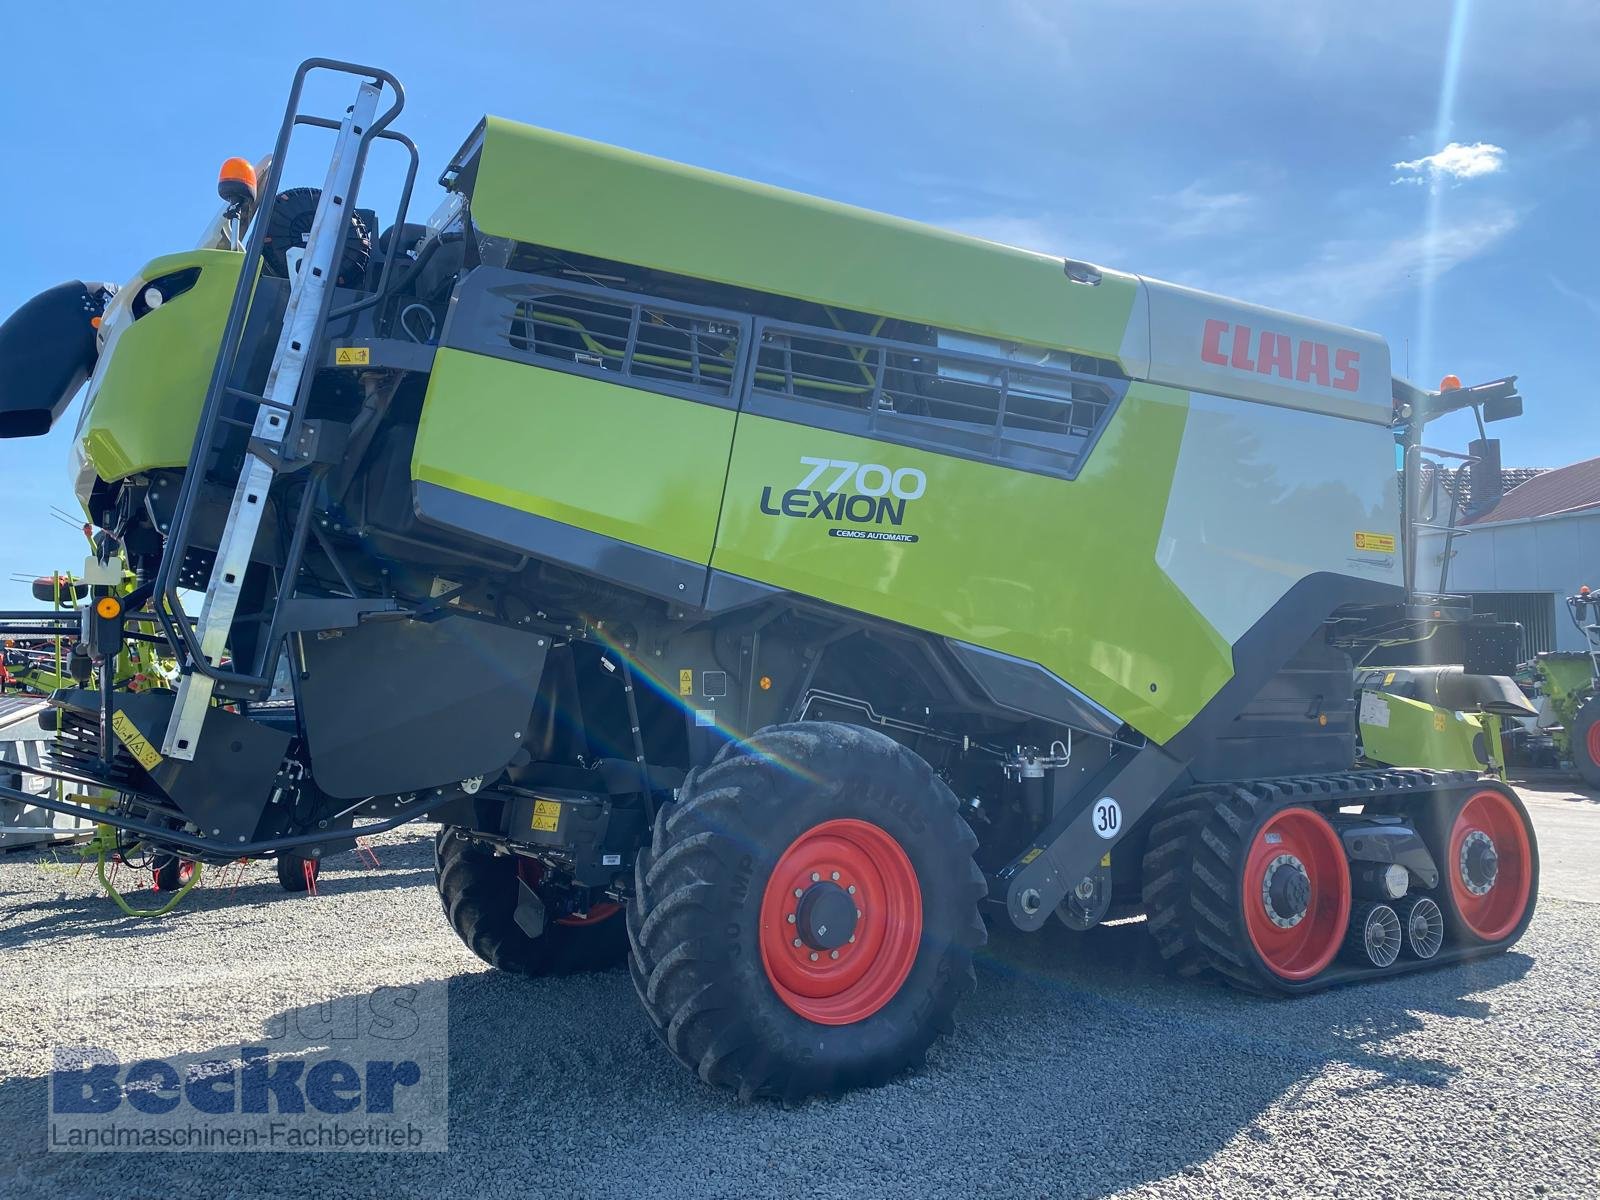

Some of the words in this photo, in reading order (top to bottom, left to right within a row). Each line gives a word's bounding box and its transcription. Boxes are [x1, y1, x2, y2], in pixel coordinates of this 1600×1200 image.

[1200, 318, 1361, 392] CLAAS
[796, 456, 927, 500] 7700
[760, 486, 906, 526] LEXION
[836, 529, 865, 539] CEMOS
[867, 531, 913, 542] AUTOMATIC
[1097, 804, 1117, 831] 30
